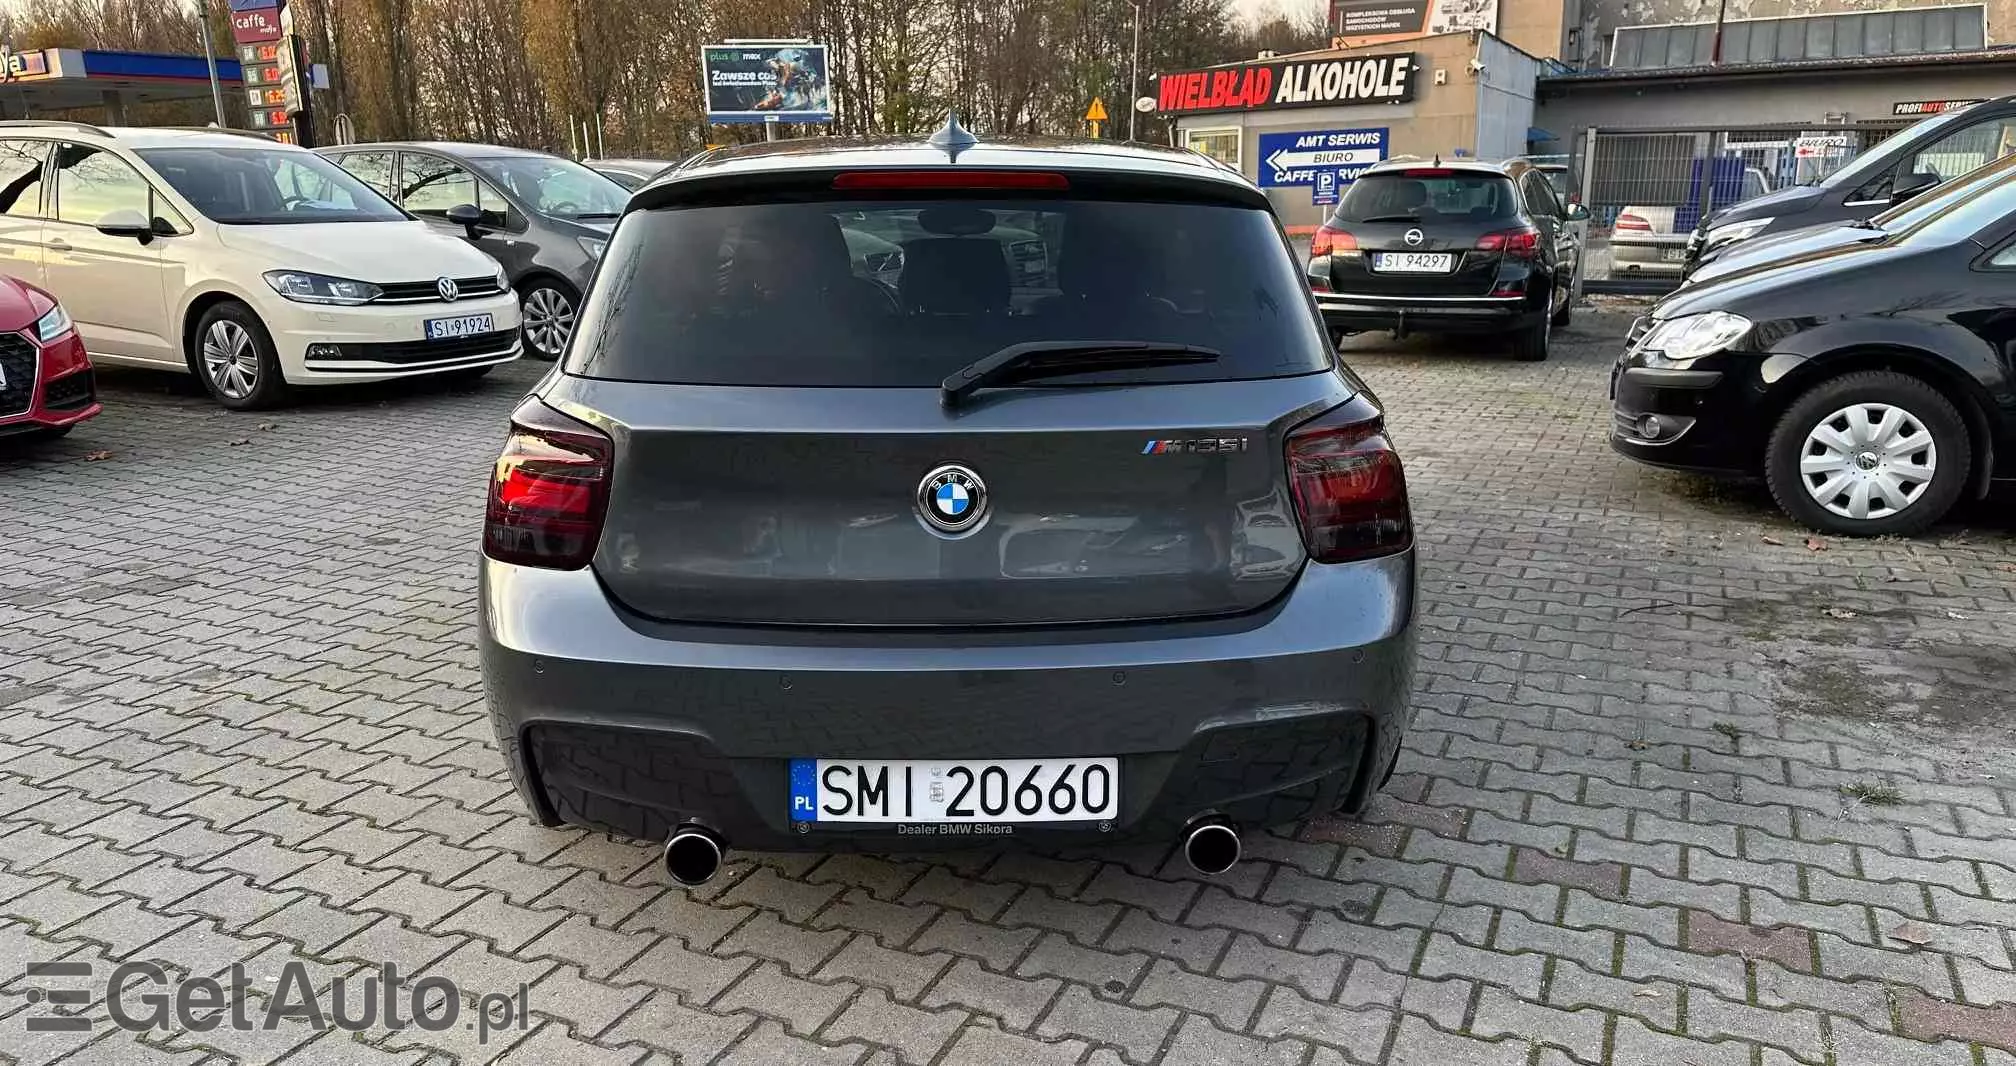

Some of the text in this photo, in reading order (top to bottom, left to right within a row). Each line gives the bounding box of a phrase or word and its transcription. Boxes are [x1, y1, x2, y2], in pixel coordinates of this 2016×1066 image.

[236, 14, 265, 29] caffe
[712, 70, 756, 80] Zawsze
[1275, 58, 1410, 103] ALKOHOLE
[1296, 133, 1380, 148] AMT SERWIS
[1313, 152, 1354, 164] BIURO
[1321, 175, 1331, 189] P
[1385, 254, 1448, 268] SI 94297
[434, 316, 491, 336] SI 91924
[931, 474, 975, 490] BMW
[794, 796, 814, 810] PL
[822, 765, 913, 817] SMI
[946, 763, 1110, 817] 20660
[898, 823, 1013, 834] Dealer BMW Sikora
